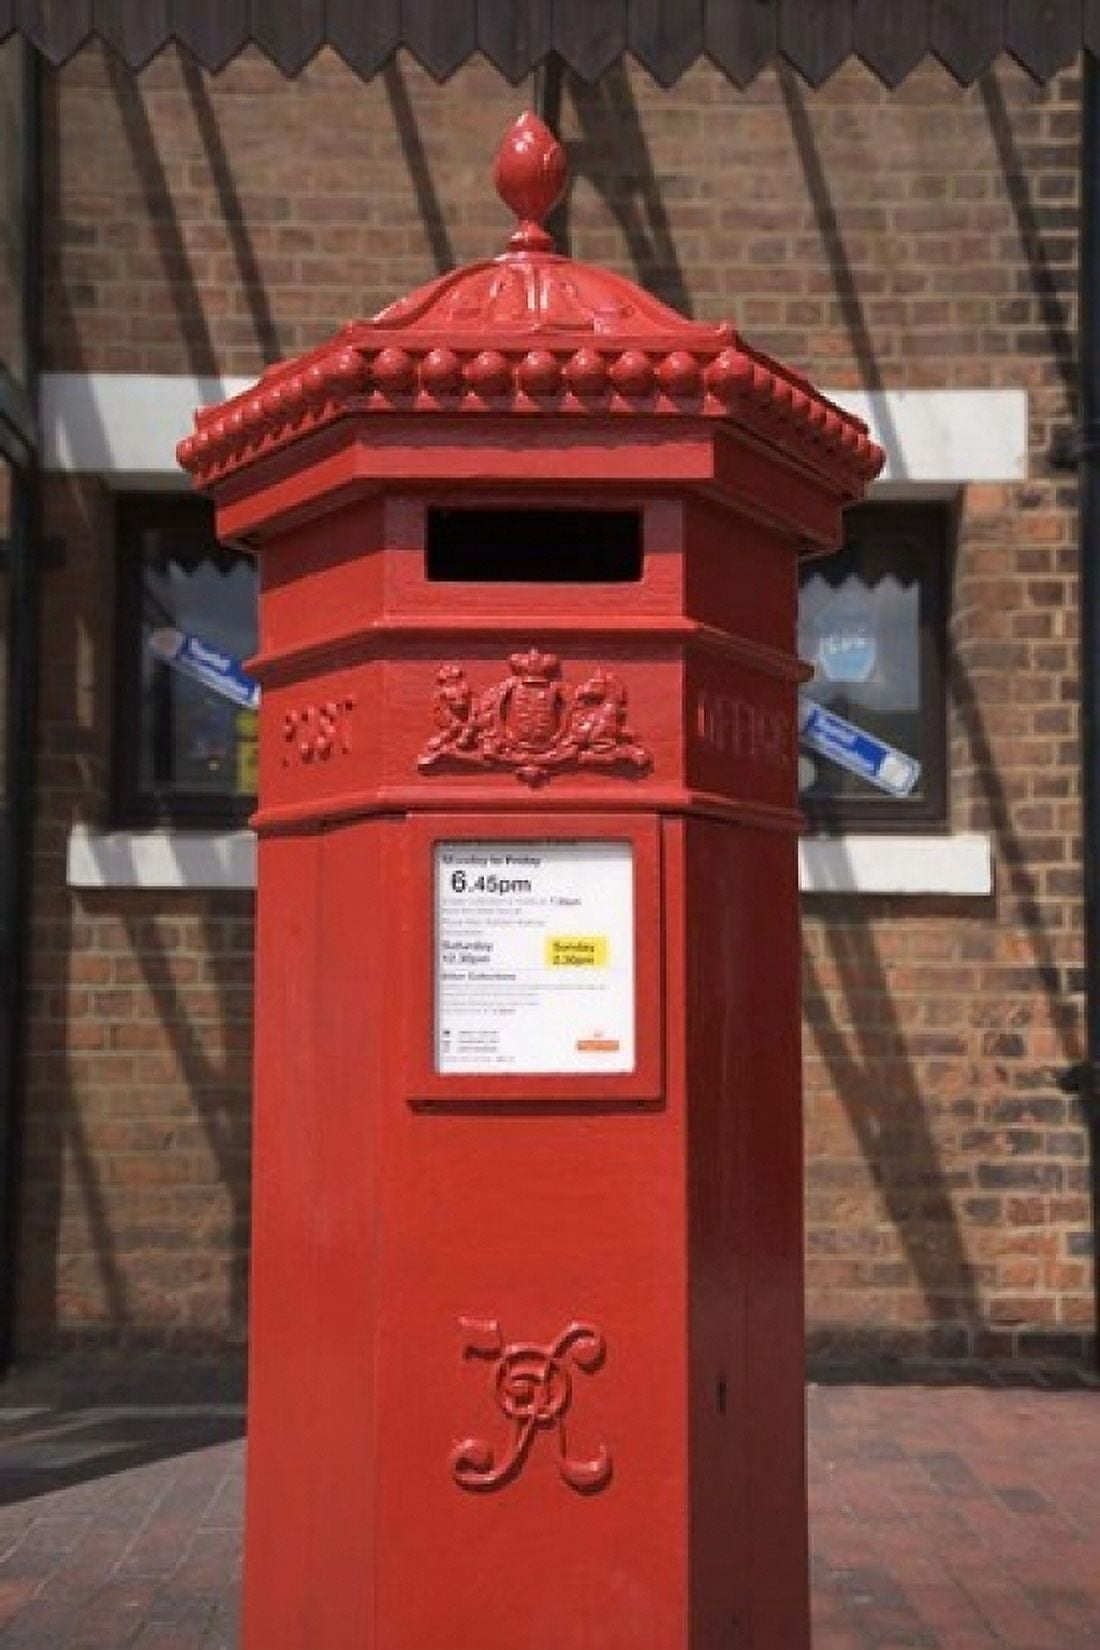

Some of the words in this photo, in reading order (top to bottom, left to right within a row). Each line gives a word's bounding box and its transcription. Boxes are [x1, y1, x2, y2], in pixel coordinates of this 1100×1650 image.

[505, 854, 541, 868] Friday
[451, 869, 532, 896] 6.45pm
[553, 940, 596, 953] Sunday
